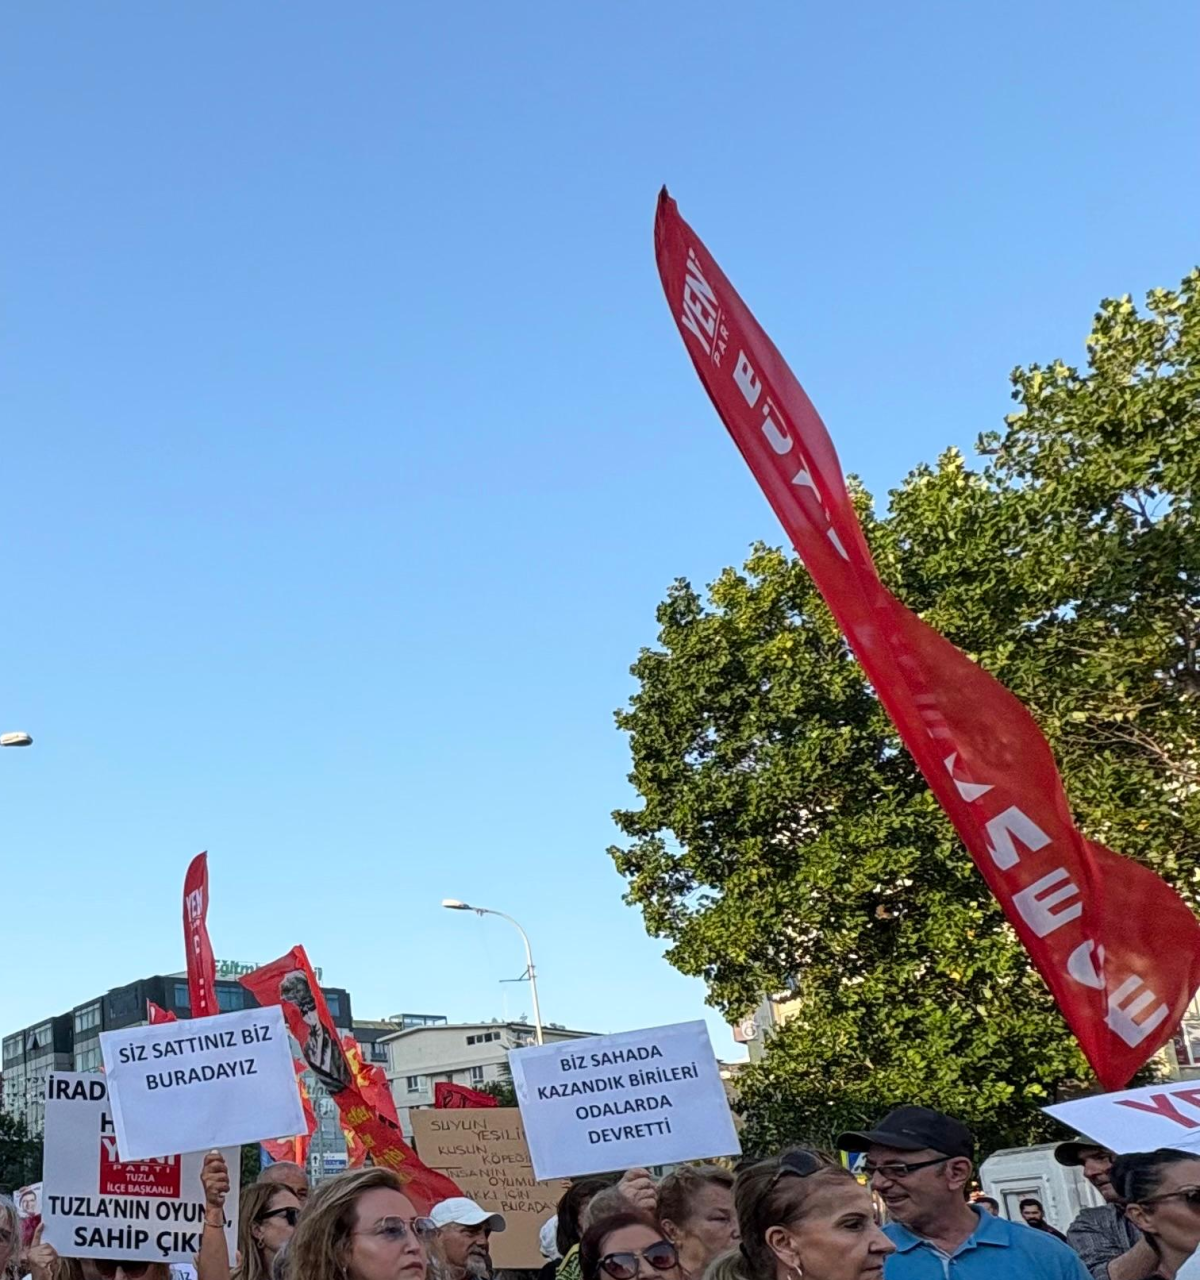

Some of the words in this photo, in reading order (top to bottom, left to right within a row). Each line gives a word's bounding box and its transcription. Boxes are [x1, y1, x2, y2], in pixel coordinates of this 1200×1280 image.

[119, 1043, 148, 1063] SİZ
[152, 1031, 237, 1059] SATTINIZ
[241, 1024, 273, 1044] BİZ
[560, 1054, 588, 1072] BİZ
[591, 1045, 663, 1068] SAHADA
[48, 1074, 110, 1101] İRAD
[146, 1059, 258, 1090] BURADAYIZ
[537, 1075, 625, 1101] KAZANDIK
[629, 1061, 699, 1087] BİRİLERİ
[575, 1094, 673, 1120] ODALARDA
[431, 1119, 487, 1131] SUYUN
[588, 1117, 672, 1144] DEVRETTİ
[107, 1182, 126, 1193] İLÇE
[125, 1173, 155, 1182] TUZLA
[74, 1225, 149, 1249] SAHİP
